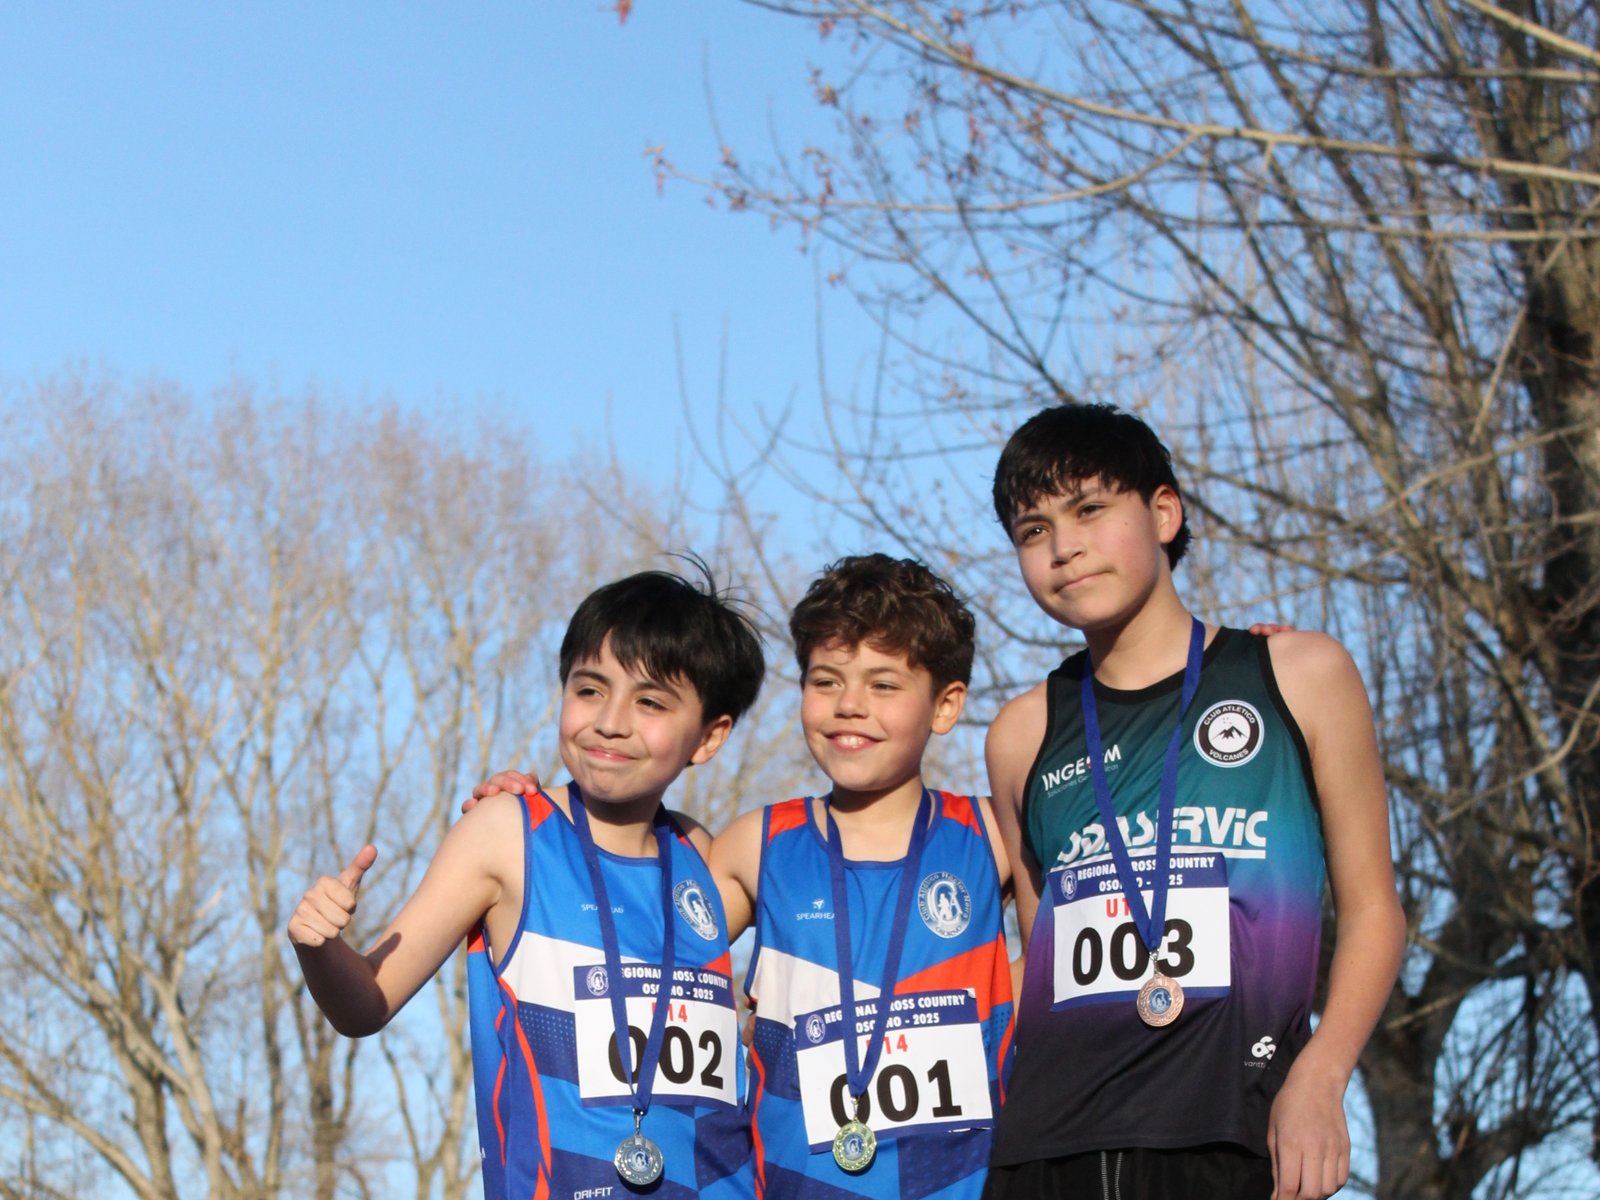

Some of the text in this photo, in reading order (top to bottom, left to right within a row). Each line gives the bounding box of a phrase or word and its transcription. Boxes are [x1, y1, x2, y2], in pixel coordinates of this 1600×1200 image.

[1204, 710, 1221, 725] CLUB
[1209, 749, 1249, 761] VOLCANES
[1077, 857, 1215, 881] REGIONA ROSS OUNTRY
[1106, 896, 1131, 918] U1
[1072, 918, 1195, 986] 003
[697, 973, 728, 990] COUNTRY
[693, 987, 714, 1000] 2025
[824, 1004, 878, 1024] REGNAL
[918, 995, 965, 1008] COUNTRY
[913, 1013, 940, 1025] 2025
[608, 1025, 723, 1090] 002
[830, 1059, 962, 1130] 001
[574, 1186, 613, 1200] DRI-FIT
